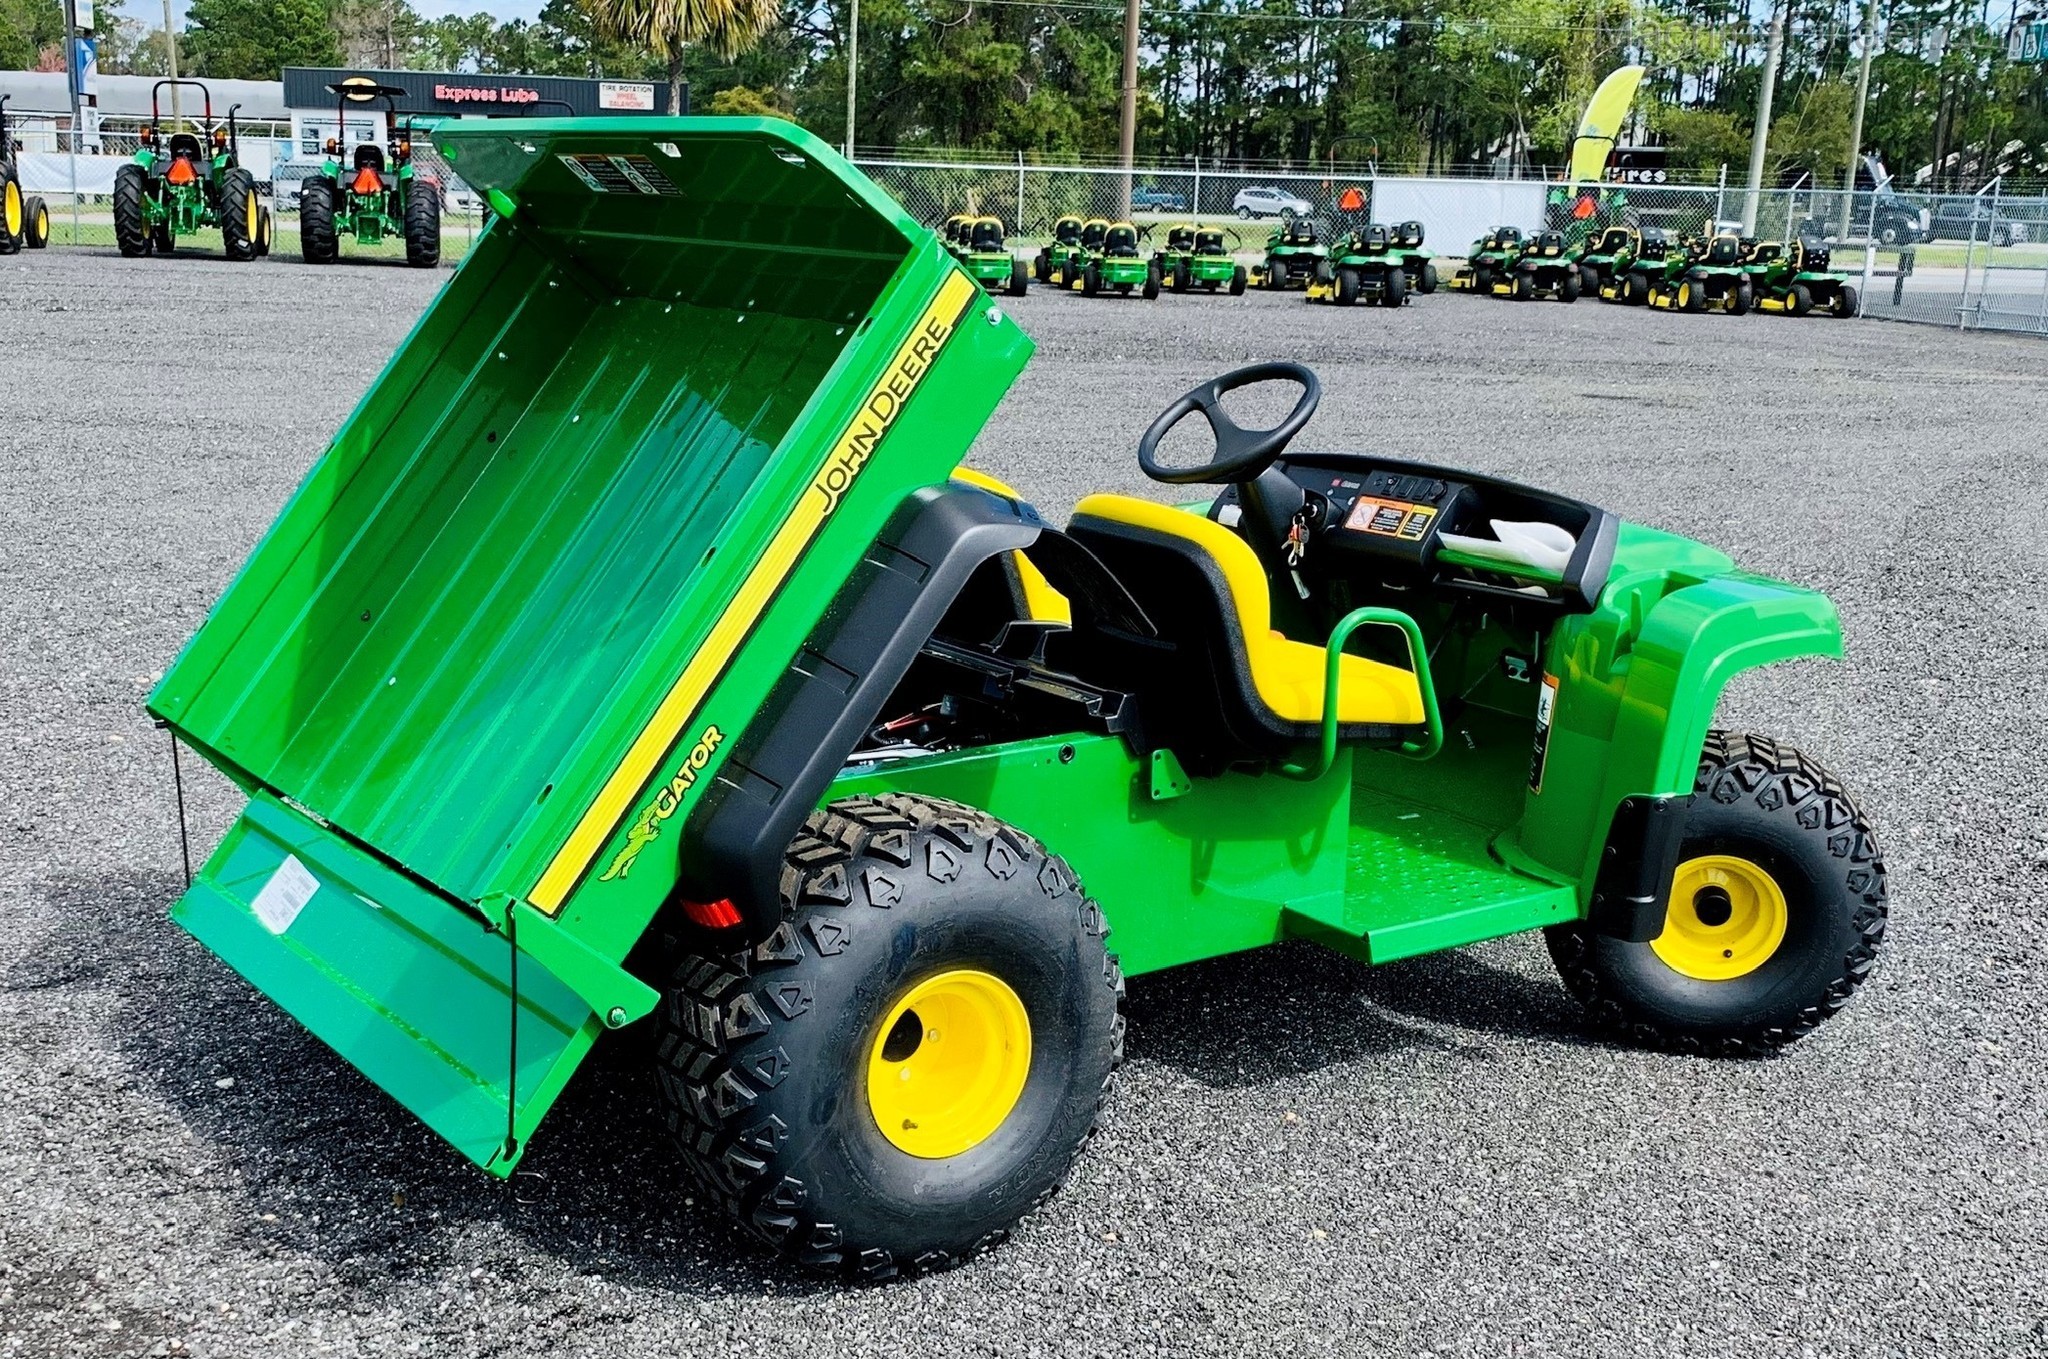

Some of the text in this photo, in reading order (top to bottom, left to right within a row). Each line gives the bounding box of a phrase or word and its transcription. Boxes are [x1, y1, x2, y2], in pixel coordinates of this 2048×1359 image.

[435, 84, 539, 102] Express Lube
[815, 316, 948, 512] JOHN DEERE
[655, 724, 726, 820] GATOR
